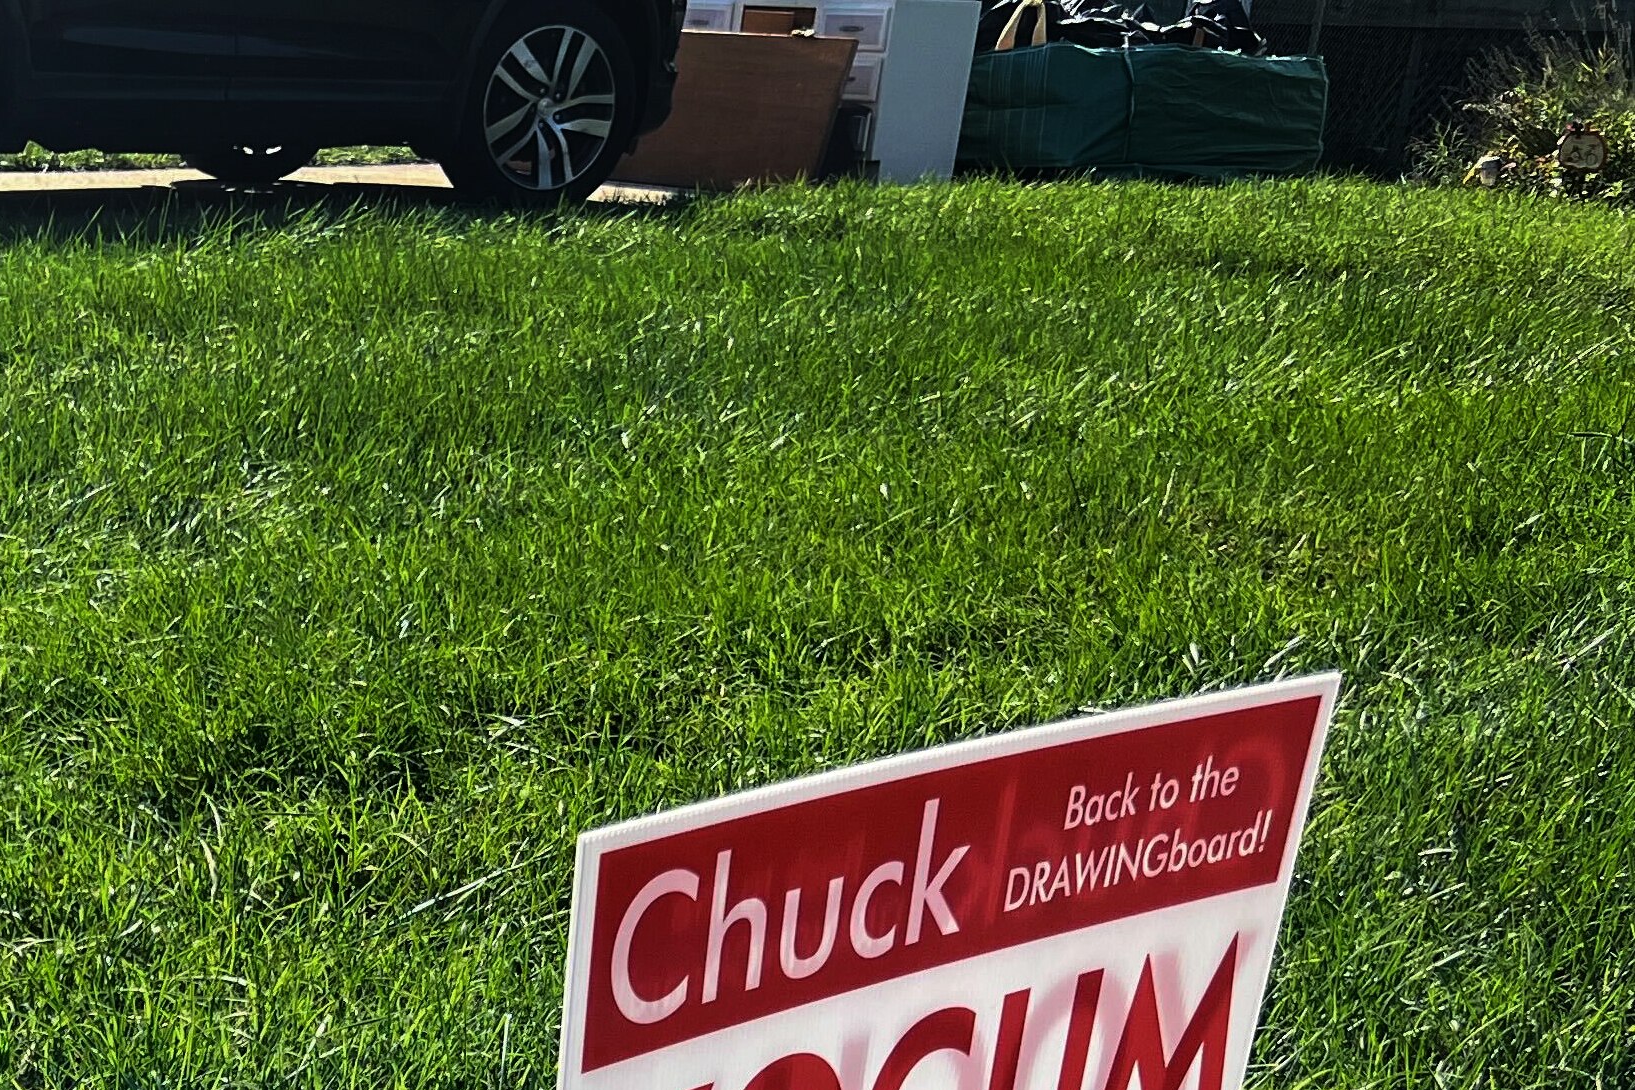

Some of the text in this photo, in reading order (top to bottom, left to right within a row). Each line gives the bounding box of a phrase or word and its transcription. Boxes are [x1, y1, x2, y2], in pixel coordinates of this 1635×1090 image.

[1064, 755, 1240, 830] Back to the
[610, 797, 971, 1026] Chuck
[1003, 809, 1273, 912] DRAWINGboard!
